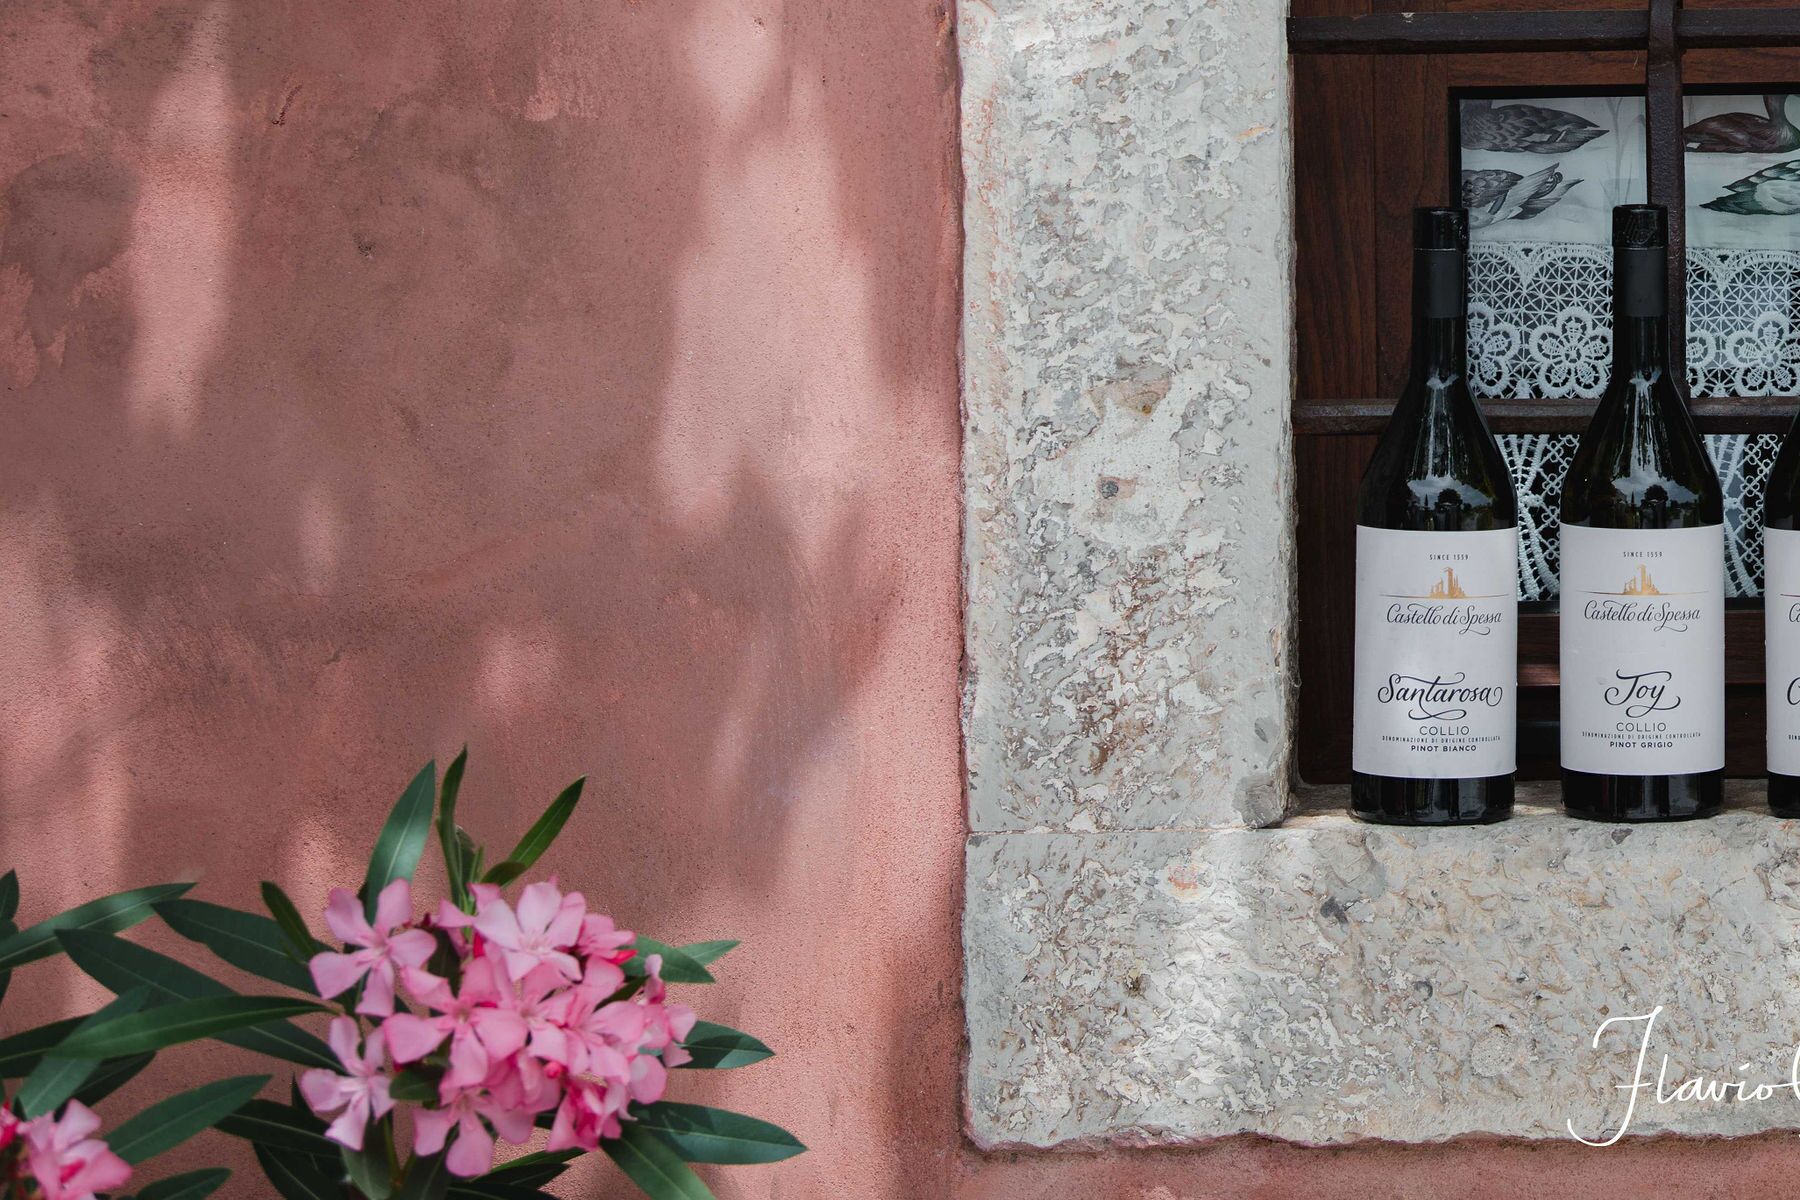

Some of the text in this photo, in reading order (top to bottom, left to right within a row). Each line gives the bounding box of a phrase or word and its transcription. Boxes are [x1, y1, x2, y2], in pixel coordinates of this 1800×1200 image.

[1387, 603, 1503, 635] Castello di Spessa
[1584, 600, 1701, 632] Castello di Spessa
[1377, 672, 1503, 720] Santarosa
[1604, 669, 1681, 718] Joy
[1382, 735, 1428, 743] DENOMINAZIONE
[1419, 726, 1470, 736] COLLIO
[1616, 722, 1667, 732] COLLIO
